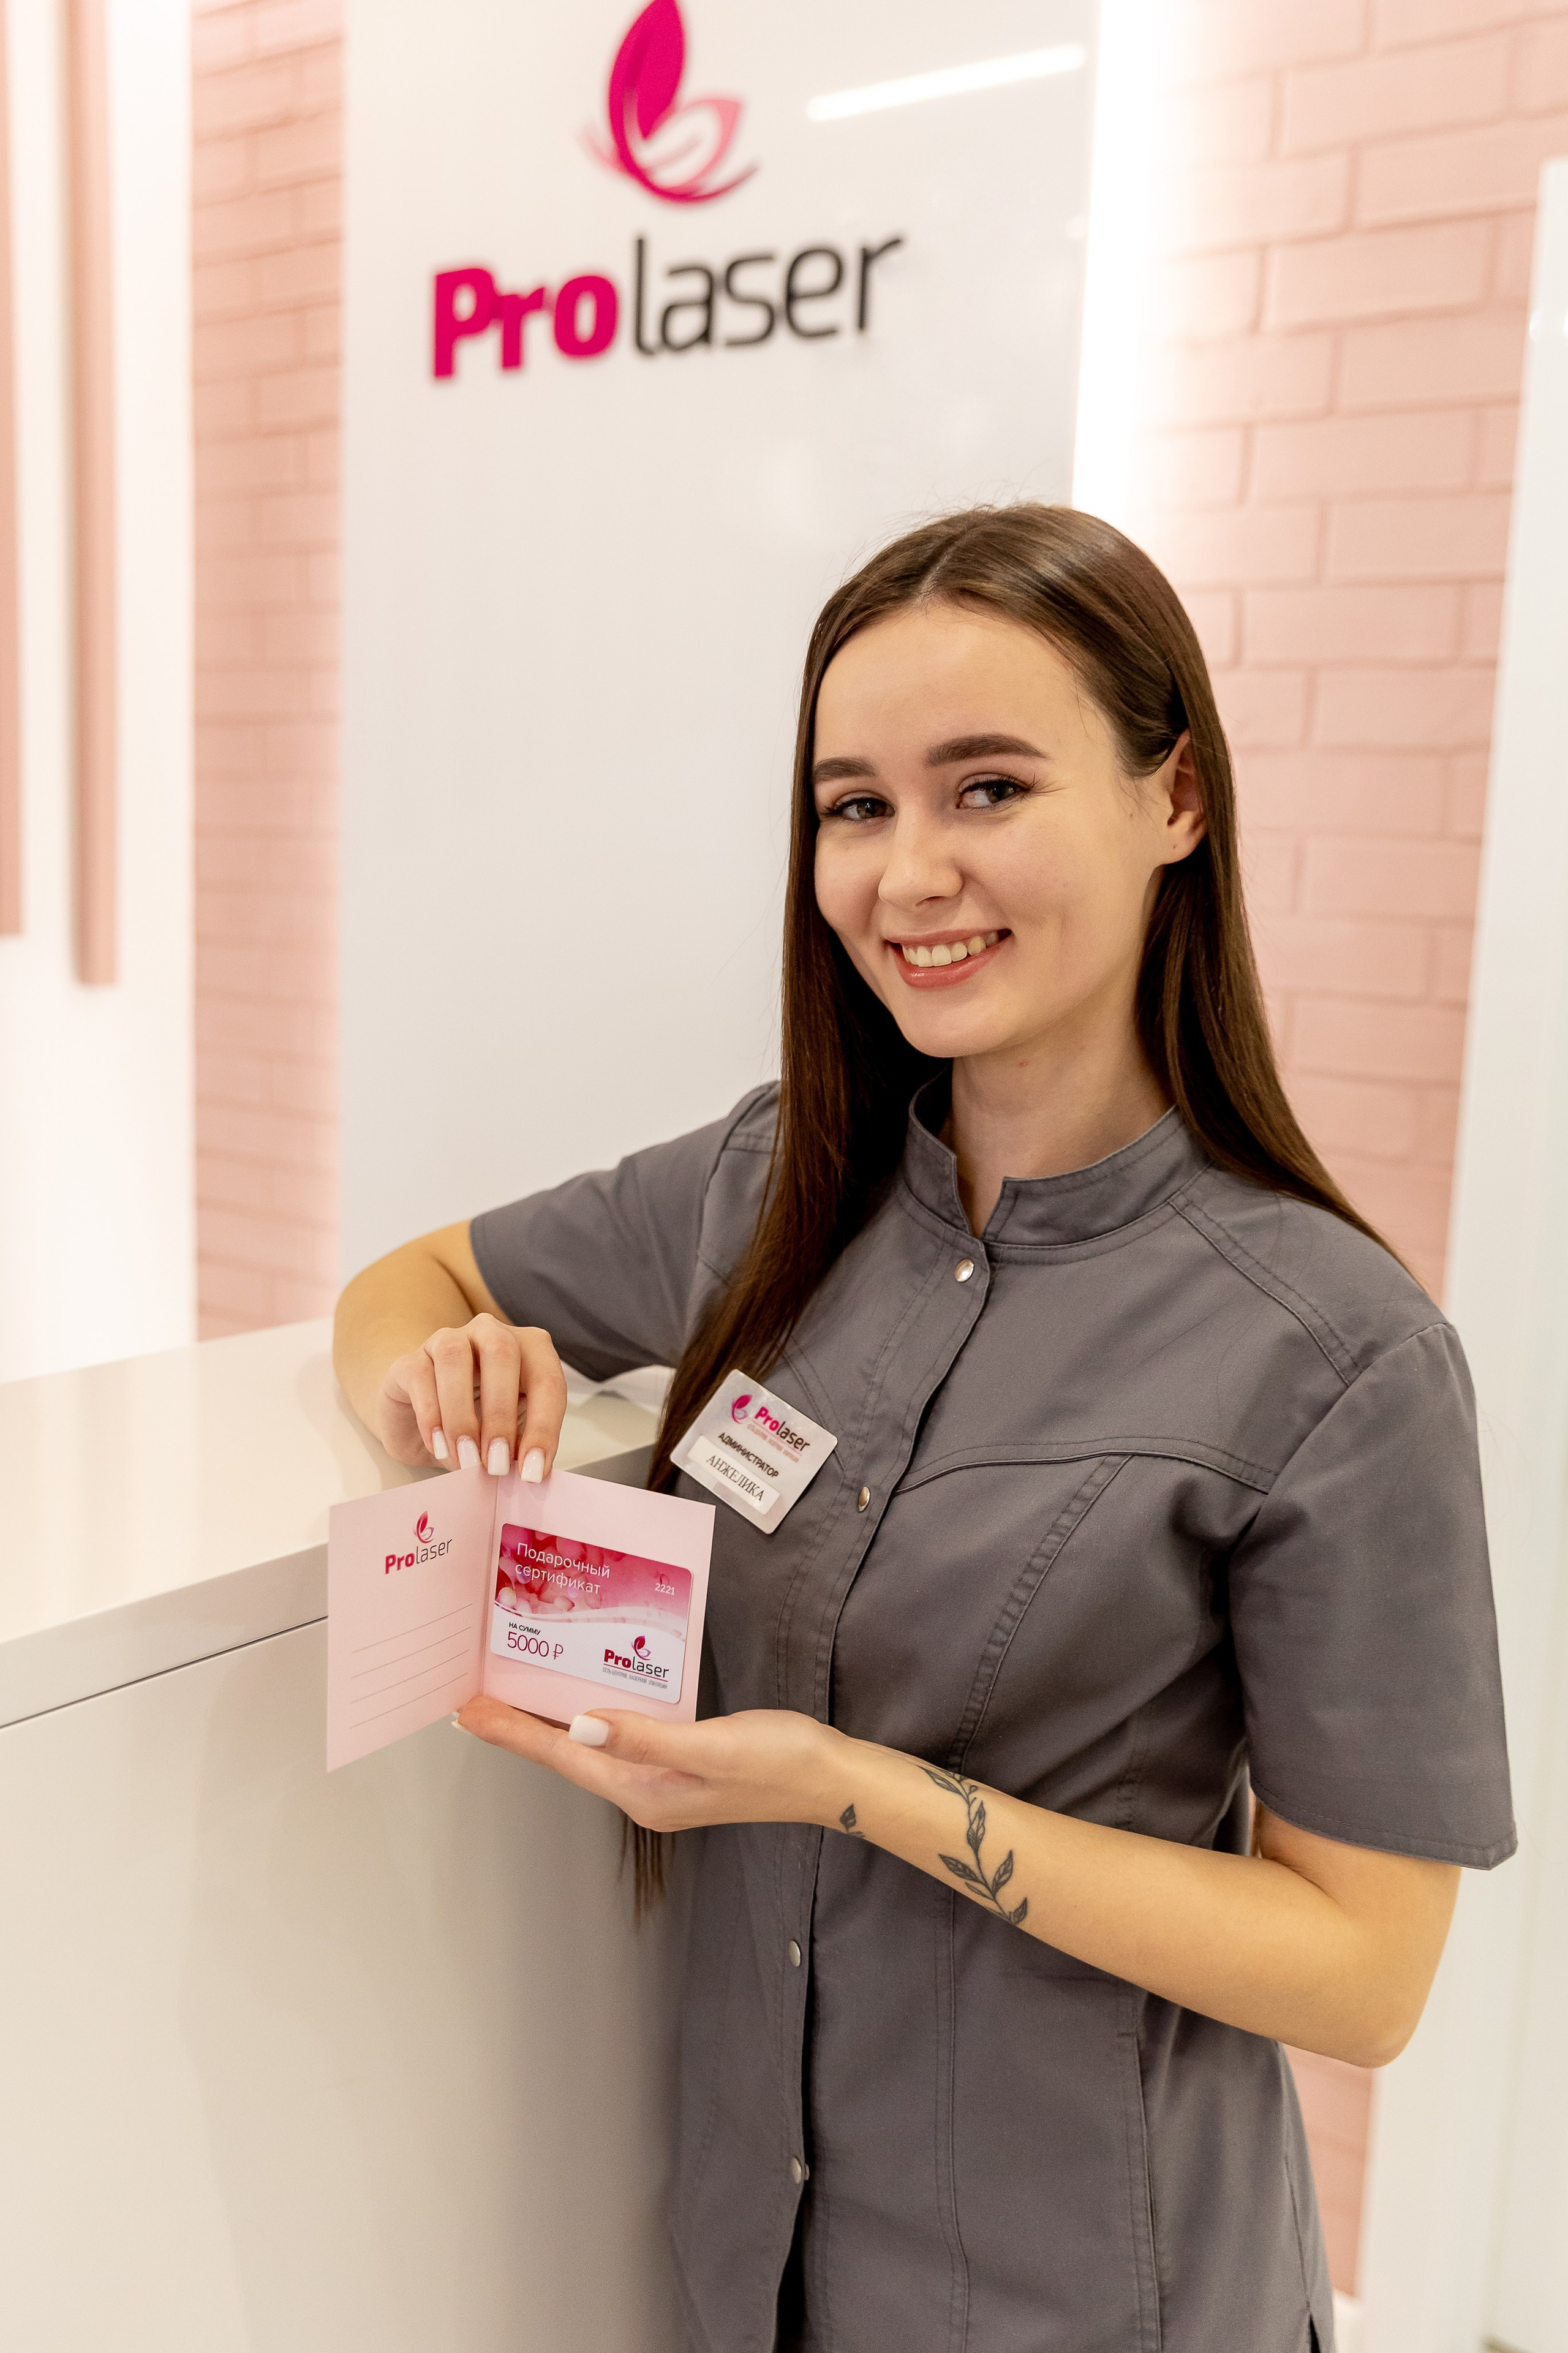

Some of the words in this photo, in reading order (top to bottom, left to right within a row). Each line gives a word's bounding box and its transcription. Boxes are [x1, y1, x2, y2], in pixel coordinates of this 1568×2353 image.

[431, 236, 904, 380] Prolaser
[754, 1406, 810, 1452] Prolaser
[718, 1432, 779, 1478] АДМИНИСТРАТОР
[706, 1455, 764, 1501] АНЖЕЛИКА
[385, 1538, 453, 1575] Prolaser
[516, 1542, 611, 1579] Подарочный
[514, 1564, 601, 1595] сертификат
[654, 1583, 676, 1595] 2221
[507, 1631, 549, 1657] 5000
[518, 1625, 541, 1636] СУММУ
[603, 1649, 669, 1678] Prolaser
